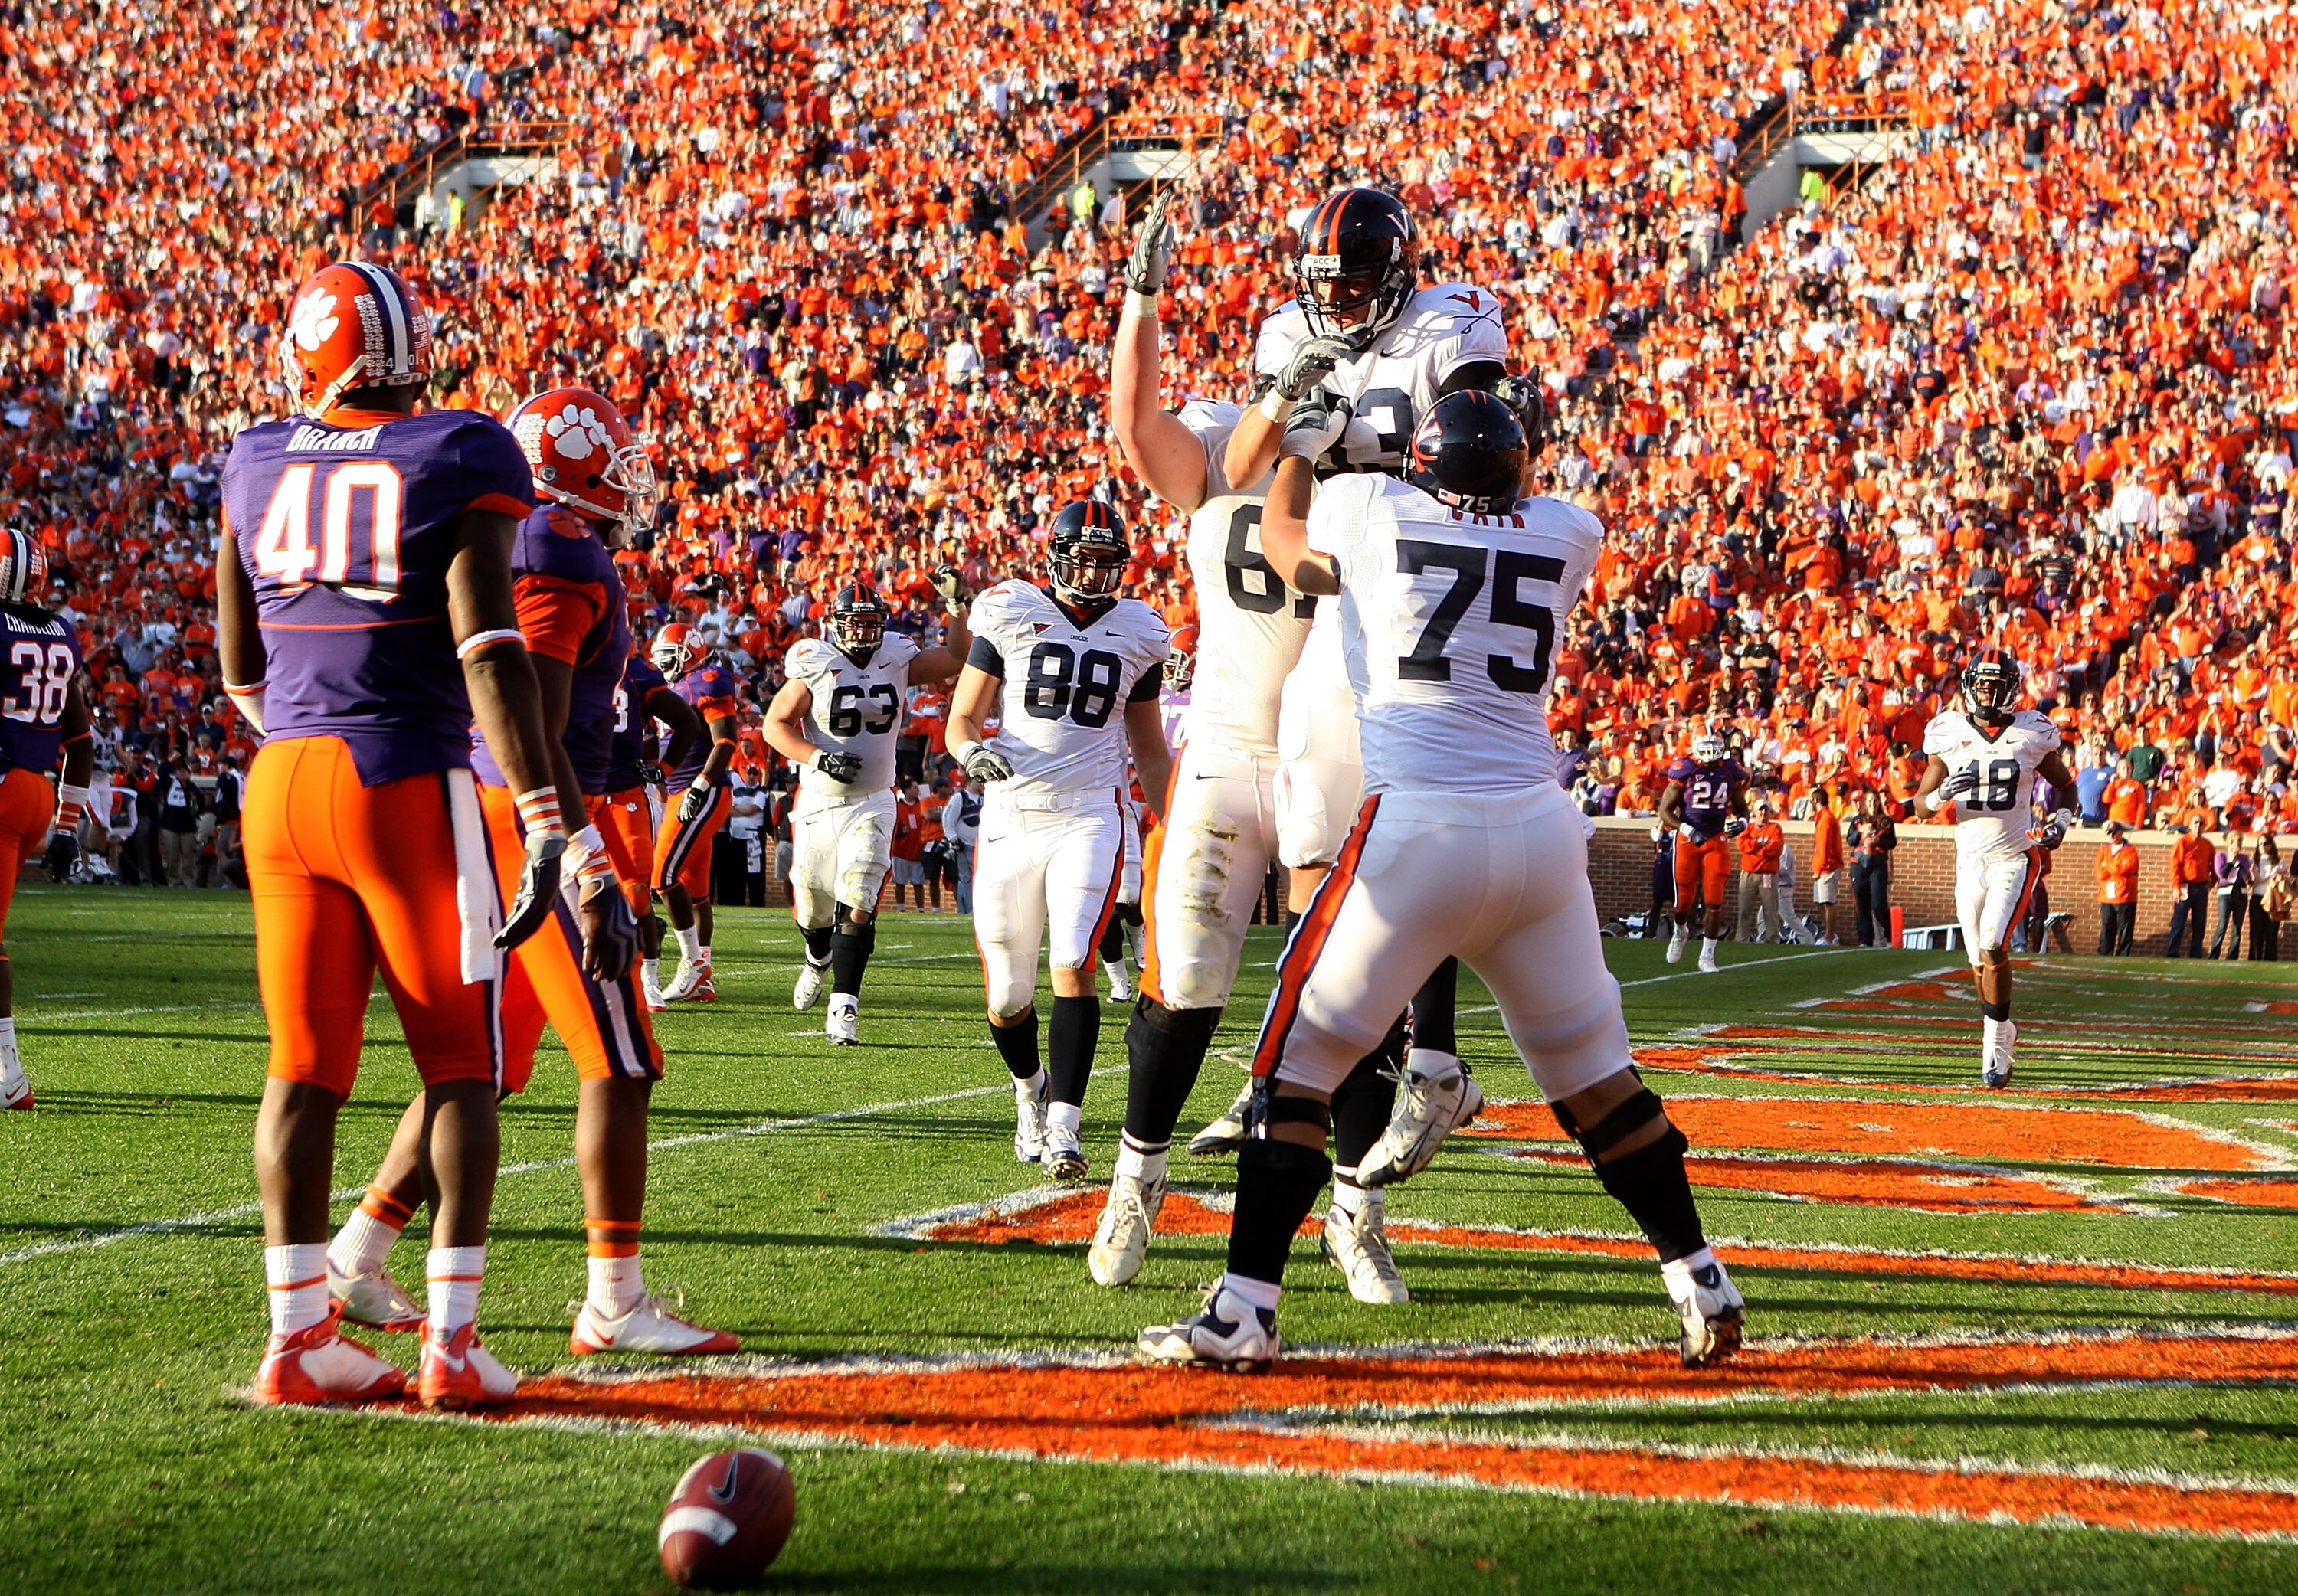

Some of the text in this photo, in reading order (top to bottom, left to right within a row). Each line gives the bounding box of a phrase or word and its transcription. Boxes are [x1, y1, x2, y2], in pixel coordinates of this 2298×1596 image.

[286, 425, 383, 452] BRANCH
[252, 460, 403, 604] 40
[1462, 494, 1491, 512] 75
[1225, 504, 1318, 619] 6
[1396, 540, 1567, 694] 75
[2, 641, 74, 724] 38
[830, 683, 899, 737] 63
[1024, 642, 1123, 729] 88
[1691, 781, 1729, 809] 24
[1965, 759, 2021, 811] 18
